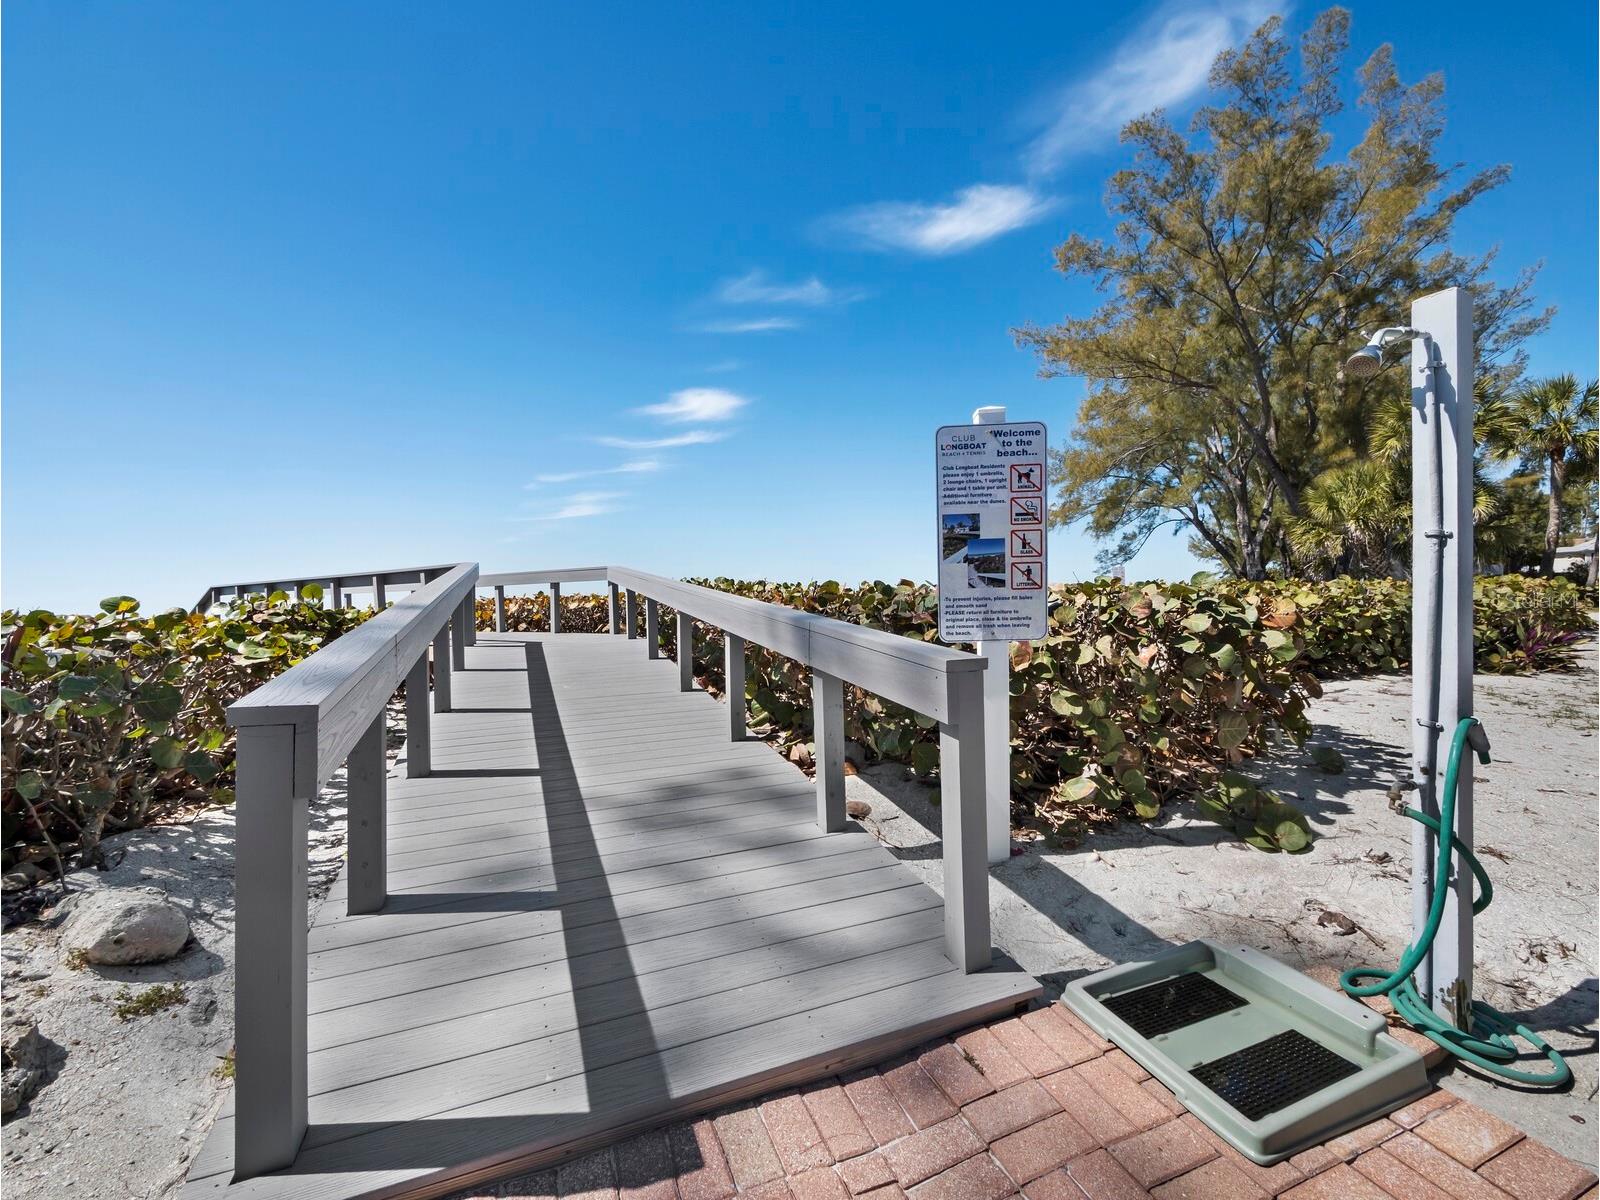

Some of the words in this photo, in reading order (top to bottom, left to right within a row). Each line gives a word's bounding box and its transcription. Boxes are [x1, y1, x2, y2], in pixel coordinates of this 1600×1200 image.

[993, 429, 1041, 438] Welcome
[951, 434, 976, 442] CLUB
[940, 442, 987, 451] LONGBOAT
[1015, 439, 1032, 447] the
[996, 449, 1038, 457] beach...
